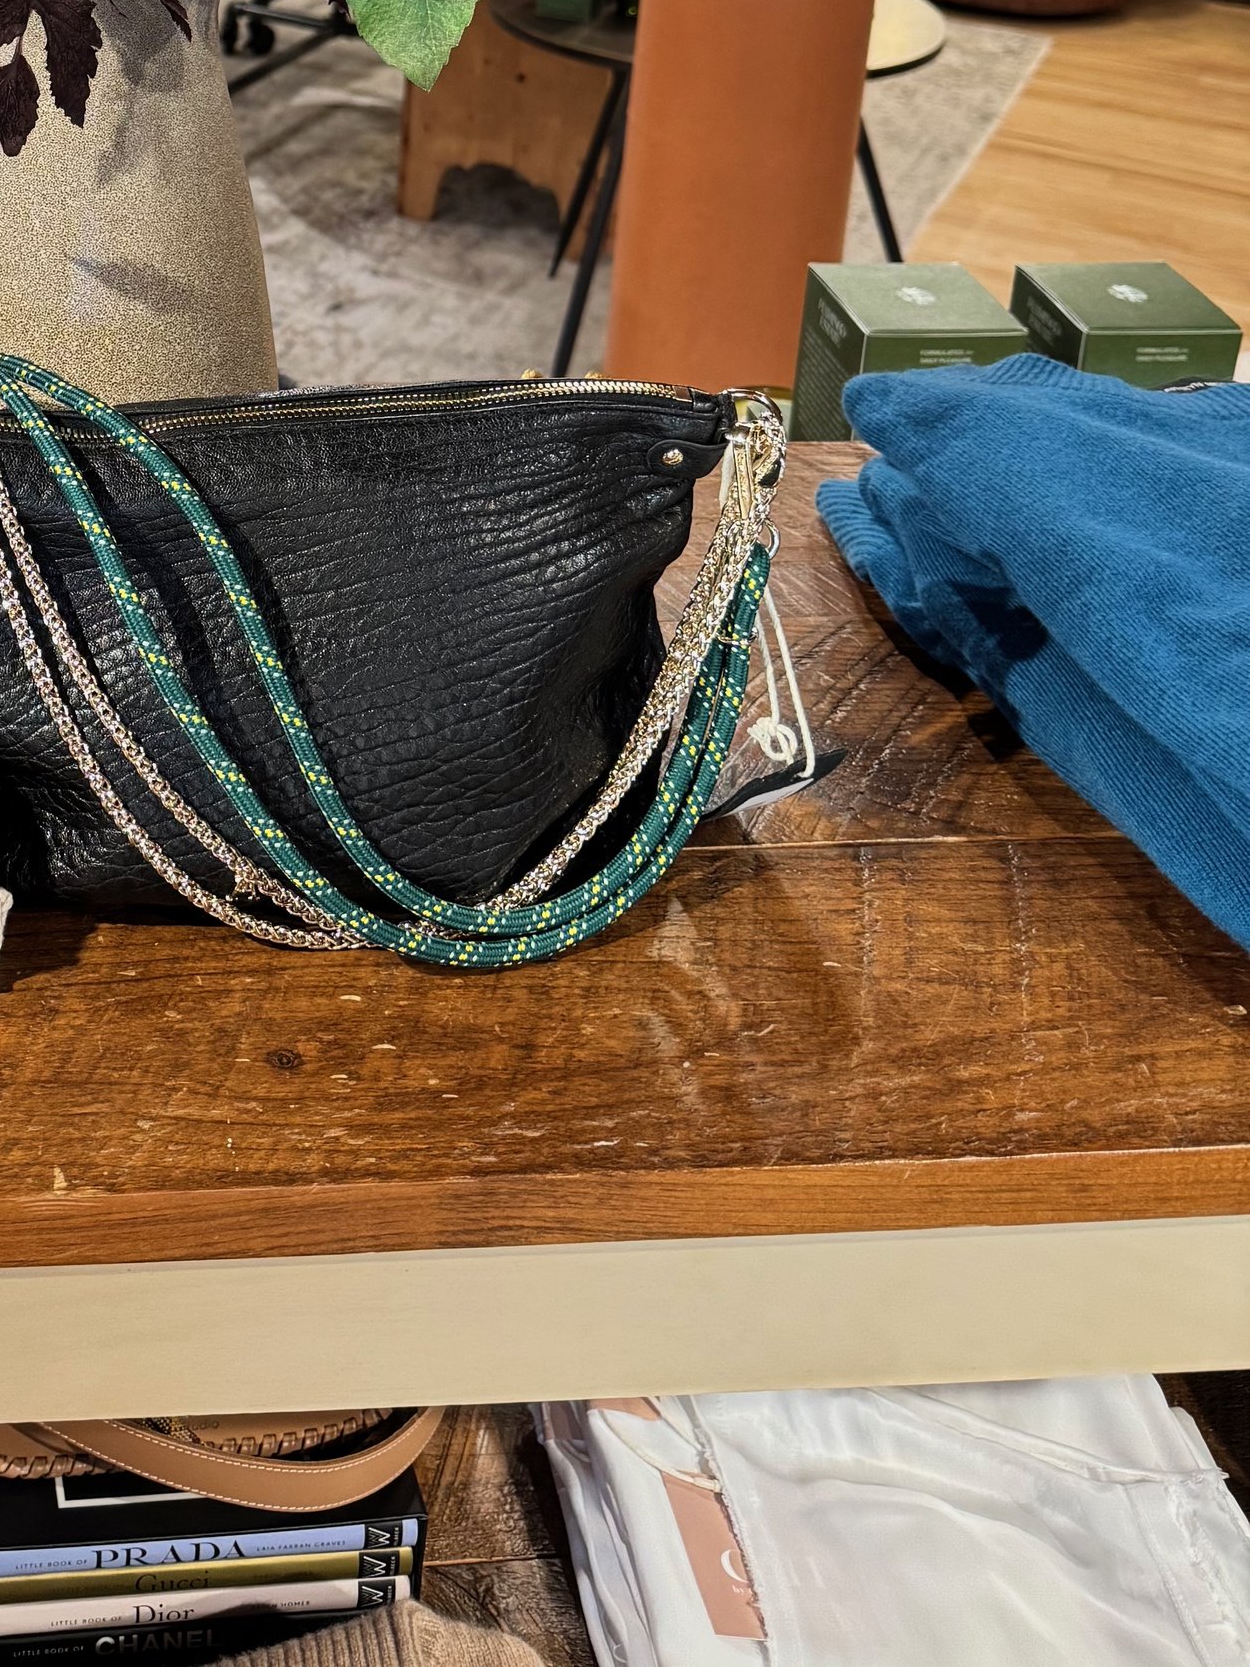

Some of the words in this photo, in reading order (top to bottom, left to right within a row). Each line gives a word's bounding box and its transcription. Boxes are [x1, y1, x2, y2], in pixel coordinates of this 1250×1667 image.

[15, 1562, 43, 1570] LITTLE
[91, 1540, 247, 1569] PRADA
[314, 1540, 346, 1548] GRAVES
[134, 1570, 210, 1592] Gucci
[50, 1619, 78, 1627] LITTLE
[132, 1603, 195, 1624] Dior
[13, 1649, 40, 1658] LITTLE
[95, 1629, 222, 1655] CHANEL
